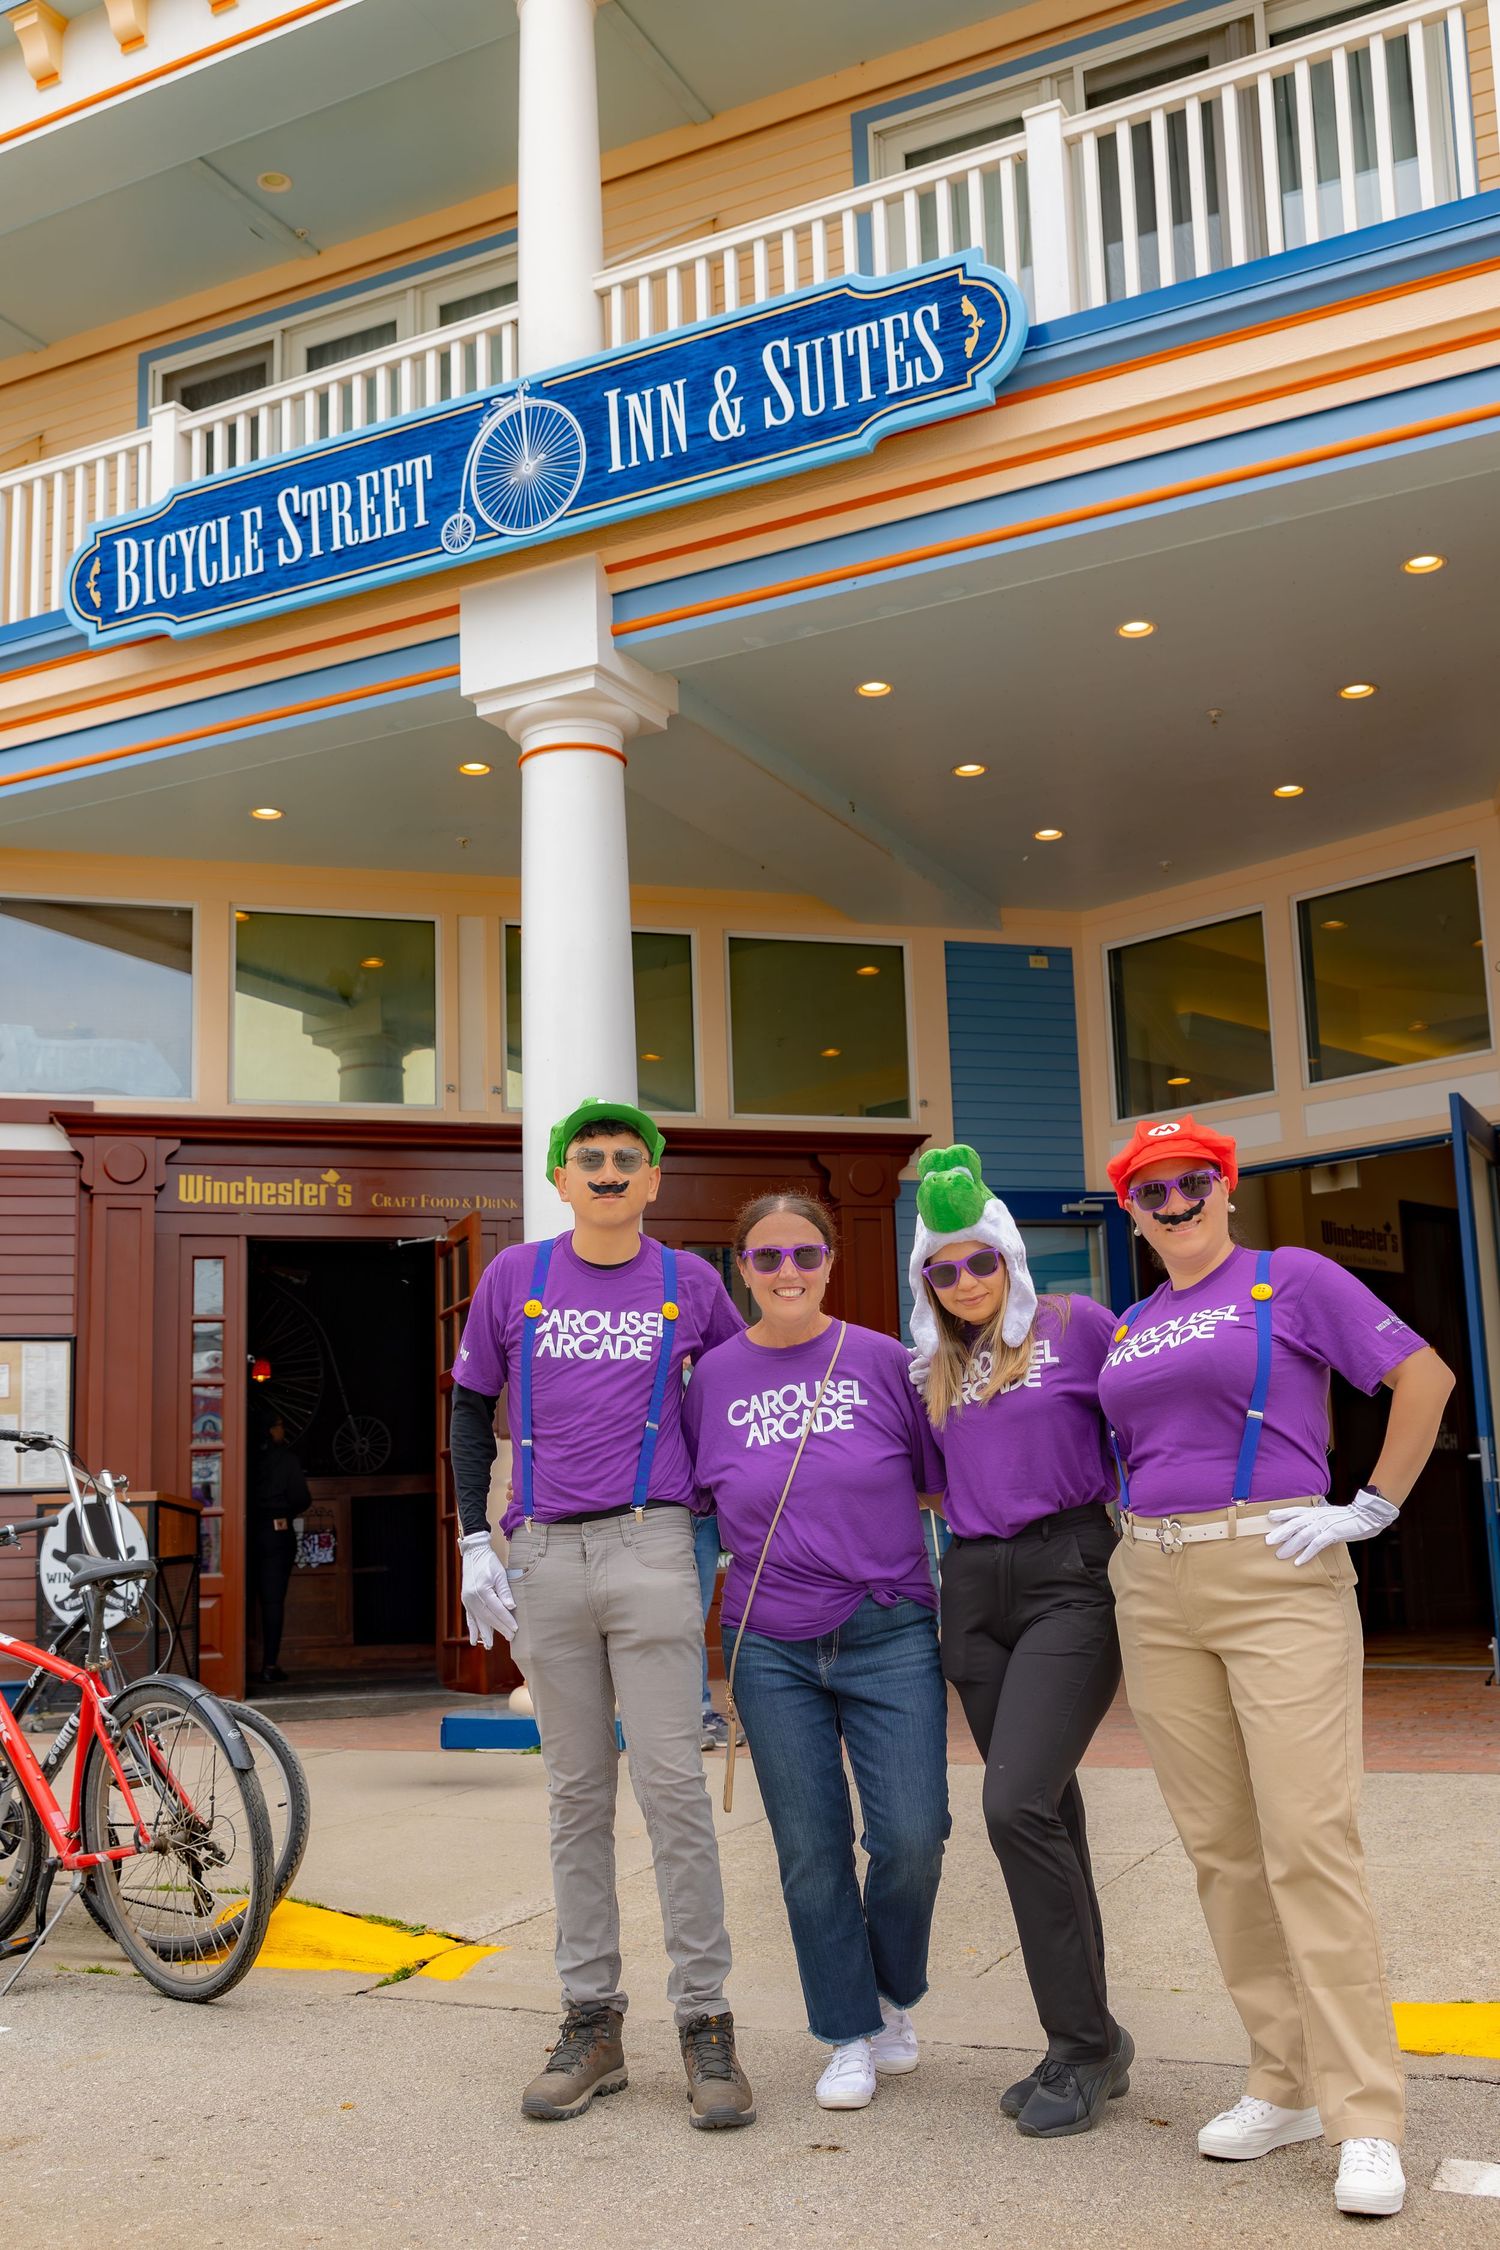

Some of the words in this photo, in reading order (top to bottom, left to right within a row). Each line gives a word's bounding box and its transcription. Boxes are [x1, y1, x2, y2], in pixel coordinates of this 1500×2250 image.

[114, 505, 264, 613] BICYCLE
[276, 454, 434, 567] STREET
[603, 378, 688, 474] INN
[708, 365, 746, 442] &
[762, 302, 945, 429] SUITES
[1154, 1125, 1175, 1135] M
[178, 1169, 352, 1207] Winchester's
[371, 1192, 416, 1208] CRAFT
[420, 1193, 459, 1209] FOOD
[462, 1198, 472, 1208] &
[475, 1195, 519, 1209] DRINK
[536, 1332, 653, 1361] ARCADE
[1101, 1321, 1217, 1374] ARCADE
[727, 1379, 868, 1427] CAROUSEL
[745, 1404, 854, 1448] ARCADE
